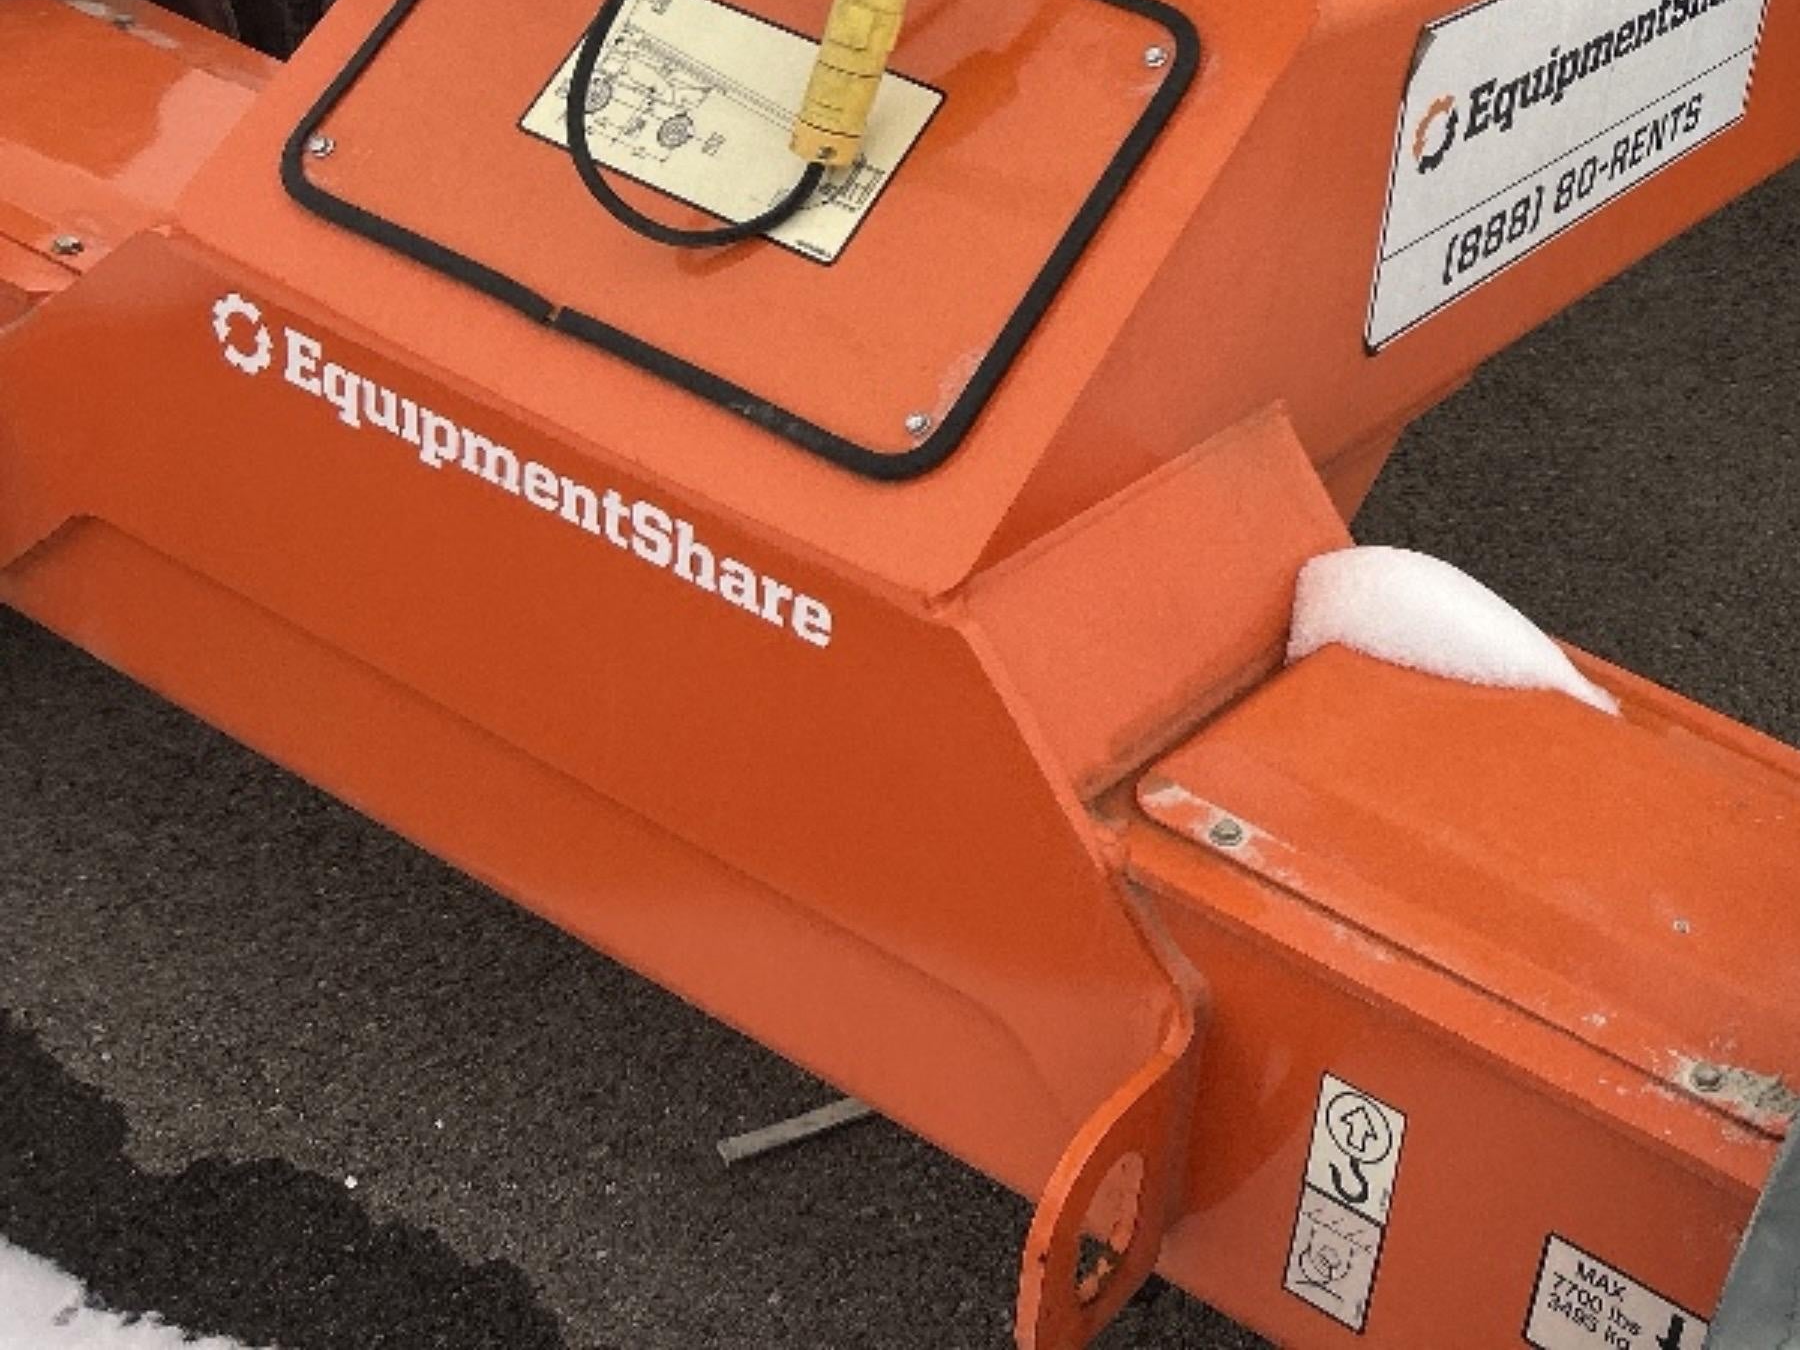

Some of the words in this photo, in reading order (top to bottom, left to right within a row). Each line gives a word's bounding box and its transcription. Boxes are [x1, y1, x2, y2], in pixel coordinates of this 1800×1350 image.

[1442, 185, 1545, 285] (888)
[1553, 92, 1703, 215] 80-RENTS
[283, 326, 832, 648] EquipmentShare
[1553, 1272, 1604, 1314] 7700
